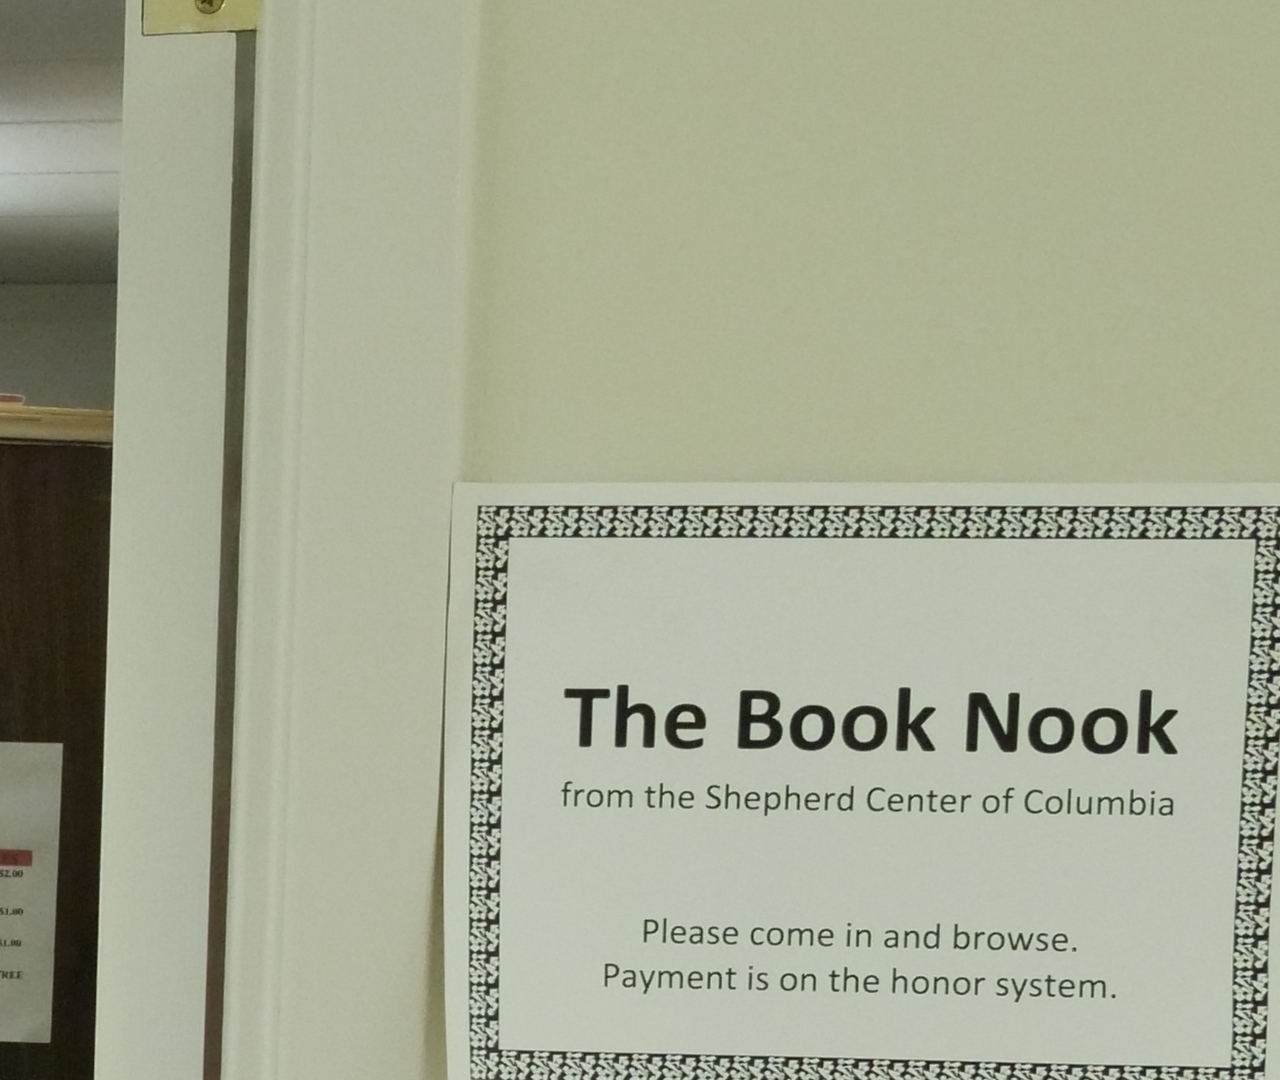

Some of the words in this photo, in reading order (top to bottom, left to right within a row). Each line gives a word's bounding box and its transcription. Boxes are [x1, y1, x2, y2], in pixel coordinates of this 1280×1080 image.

[564, 685, 707, 750] The
[737, 687, 937, 752] Book
[965, 689, 1179, 755] Nook
[560, 781, 634, 809] from
[644, 783, 695, 810] the
[705, 783, 855, 817] Shepherd
[866, 787, 972, 815] Center
[982, 788, 1016, 815] of
[1024, 788, 1175, 818] Columbia
[643, 917, 739, 948] Please
[751, 926, 835, 948] come
[846, 922, 872, 948] in
[883, 922, 941, 950] and
[953, 923, 1078, 954] browse.
[604, 963, 737, 996] Payment
[748, 966, 769, 992] is
[779, 972, 818, 993] on
[828, 967, 880, 994] the
[891, 967, 986, 998] honor
[995, 973, 1118, 1003] system.
